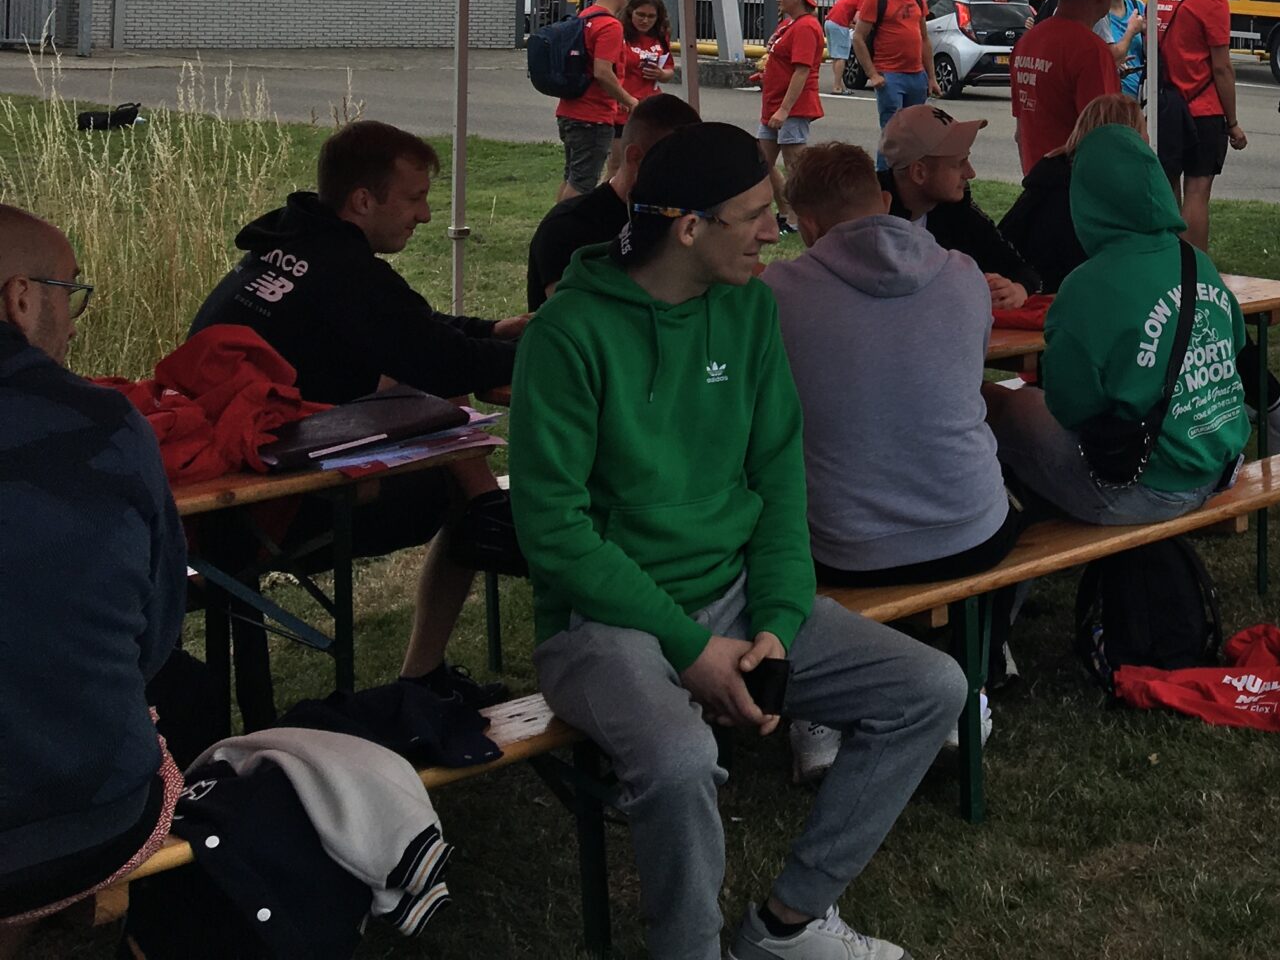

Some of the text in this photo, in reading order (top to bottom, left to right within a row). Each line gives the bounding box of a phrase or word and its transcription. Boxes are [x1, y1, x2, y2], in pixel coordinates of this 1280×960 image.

[1136, 297, 1173, 368] SLOW
[1179, 337, 1232, 375] PORTY
[706, 375, 728, 384] adidas
